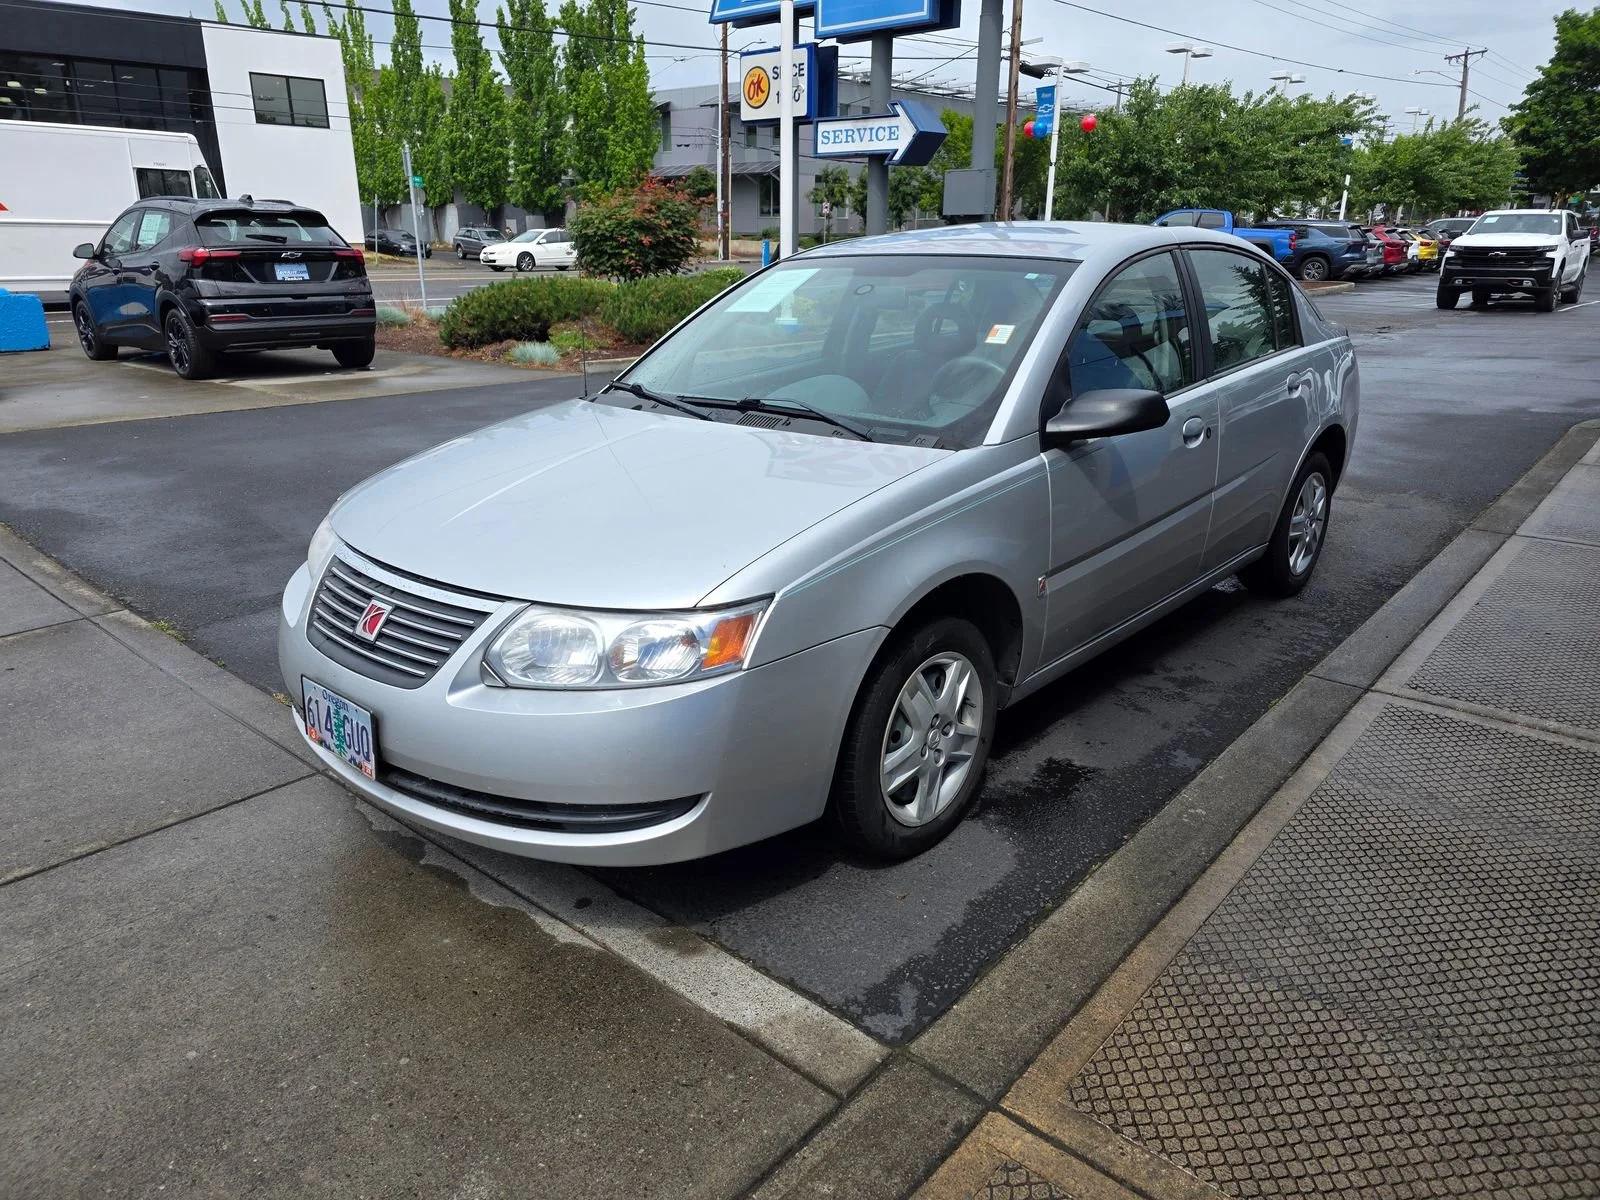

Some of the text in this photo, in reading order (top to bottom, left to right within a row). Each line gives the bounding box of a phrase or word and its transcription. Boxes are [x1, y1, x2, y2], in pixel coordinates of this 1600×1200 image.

[772, 63, 805, 80] SICE
[747, 73, 765, 101] OK
[776, 88, 801, 104] 10
[820, 125, 900, 145] SERVICE
[322, 689, 349, 713] Oregon
[307, 696, 371, 762] 614 GUQ
